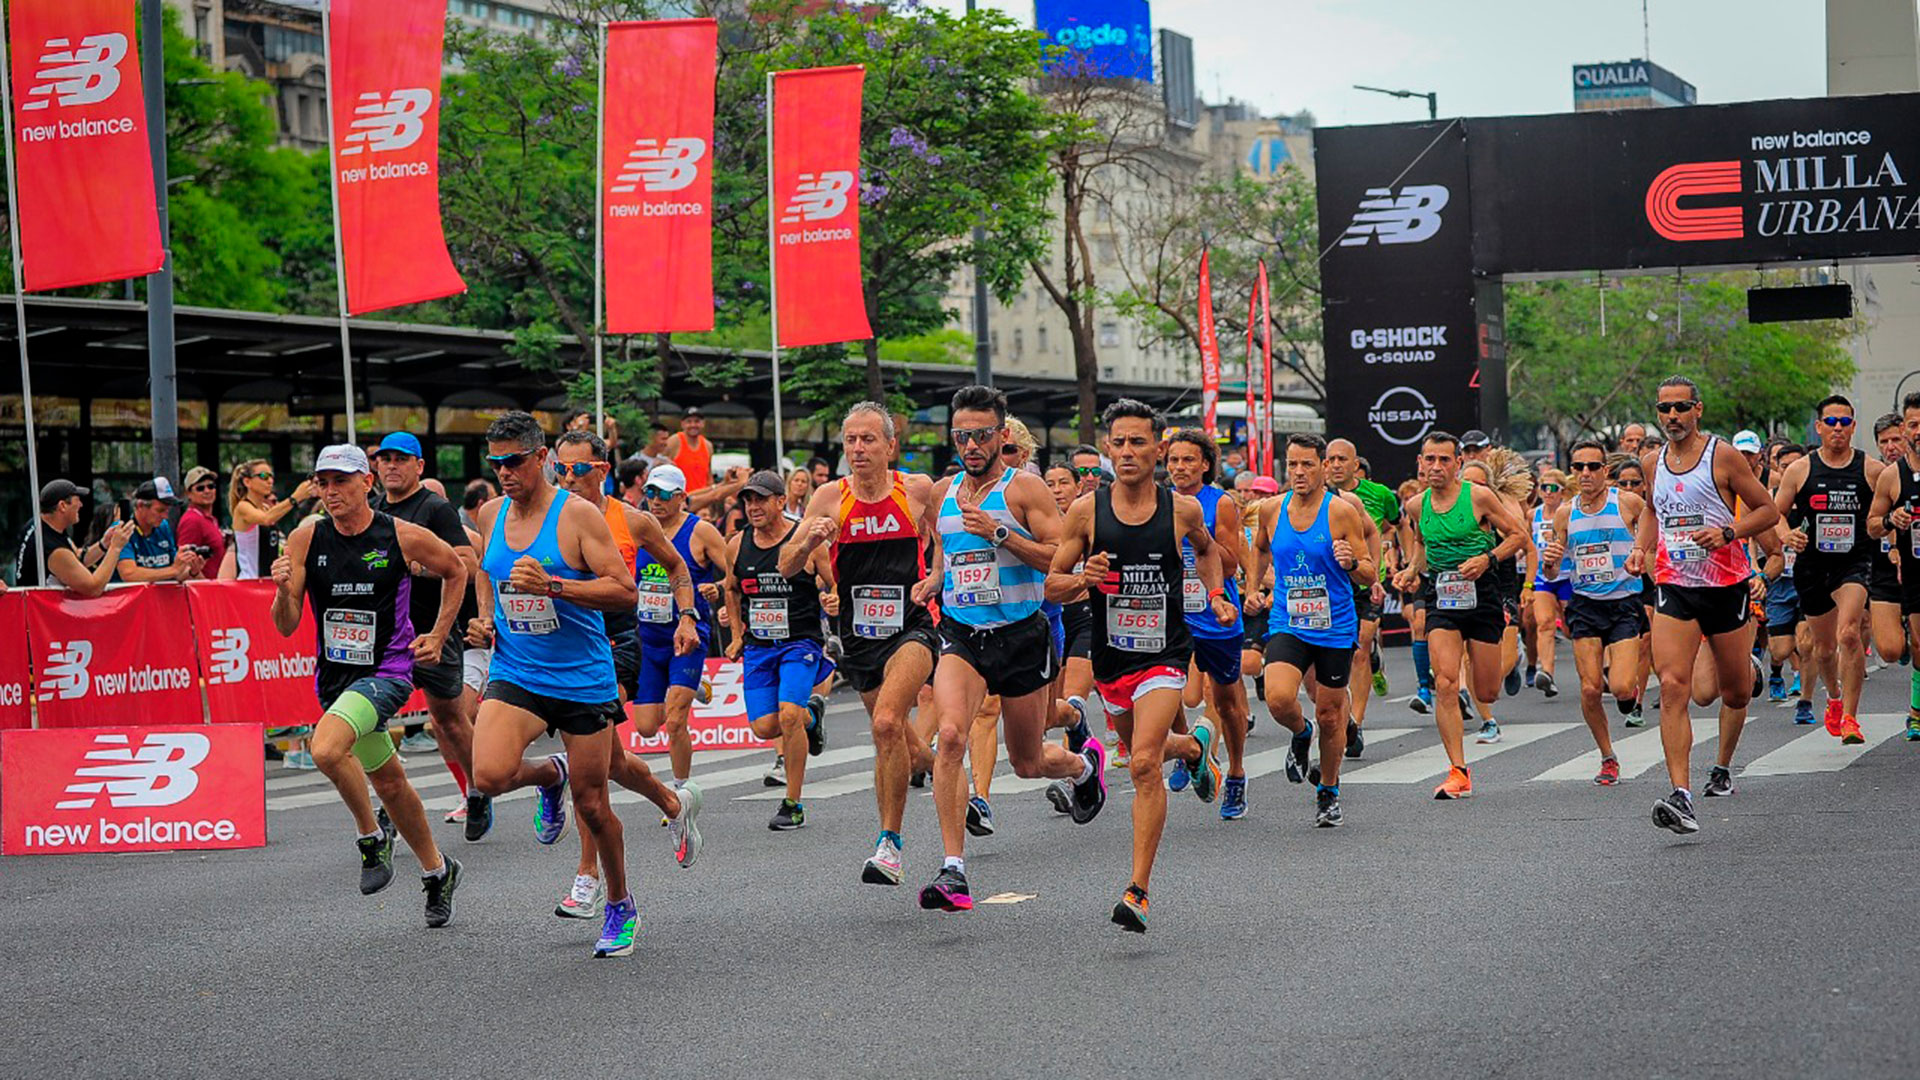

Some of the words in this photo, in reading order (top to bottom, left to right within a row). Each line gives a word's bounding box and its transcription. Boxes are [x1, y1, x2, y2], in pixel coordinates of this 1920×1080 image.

[1056, 23, 1128, 50] osde
[1575, 66, 1649, 87] QUALIA
[22, 125, 56, 142] new
[1751, 133, 1789, 151] new
[1793, 129, 1871, 148] balance
[341, 168, 367, 184] new
[1754, 151, 1907, 194] MILLA
[609, 203, 640, 217] new
[1756, 195, 1920, 238] URBANA
[780, 232, 802, 246] new
[1350, 325, 1448, 350] G-SHOCK
[1364, 350, 1436, 364] G-SQUAD
[1368, 410, 1437, 423] NISSAN
[850, 513, 901, 537] FILA
[1822, 527, 1851, 538] 1509
[957, 567, 991, 585] 1597
[1122, 571, 1165, 583] MILLA
[1122, 583, 1169, 595] URBANA
[1184, 582, 1201, 594] 82
[508, 599, 546, 613] 1573
[863, 604, 895, 618] 1619
[1295, 600, 1324, 613] 1614
[754, 612, 783, 623] 1506
[1117, 613, 1159, 628] 1563
[331, 626, 369, 642] 1530
[253, 657, 280, 681] new
[281, 652, 317, 679] balan
[94, 674, 127, 697] new
[129, 666, 191, 693] balance
[25, 822, 92, 847] new
